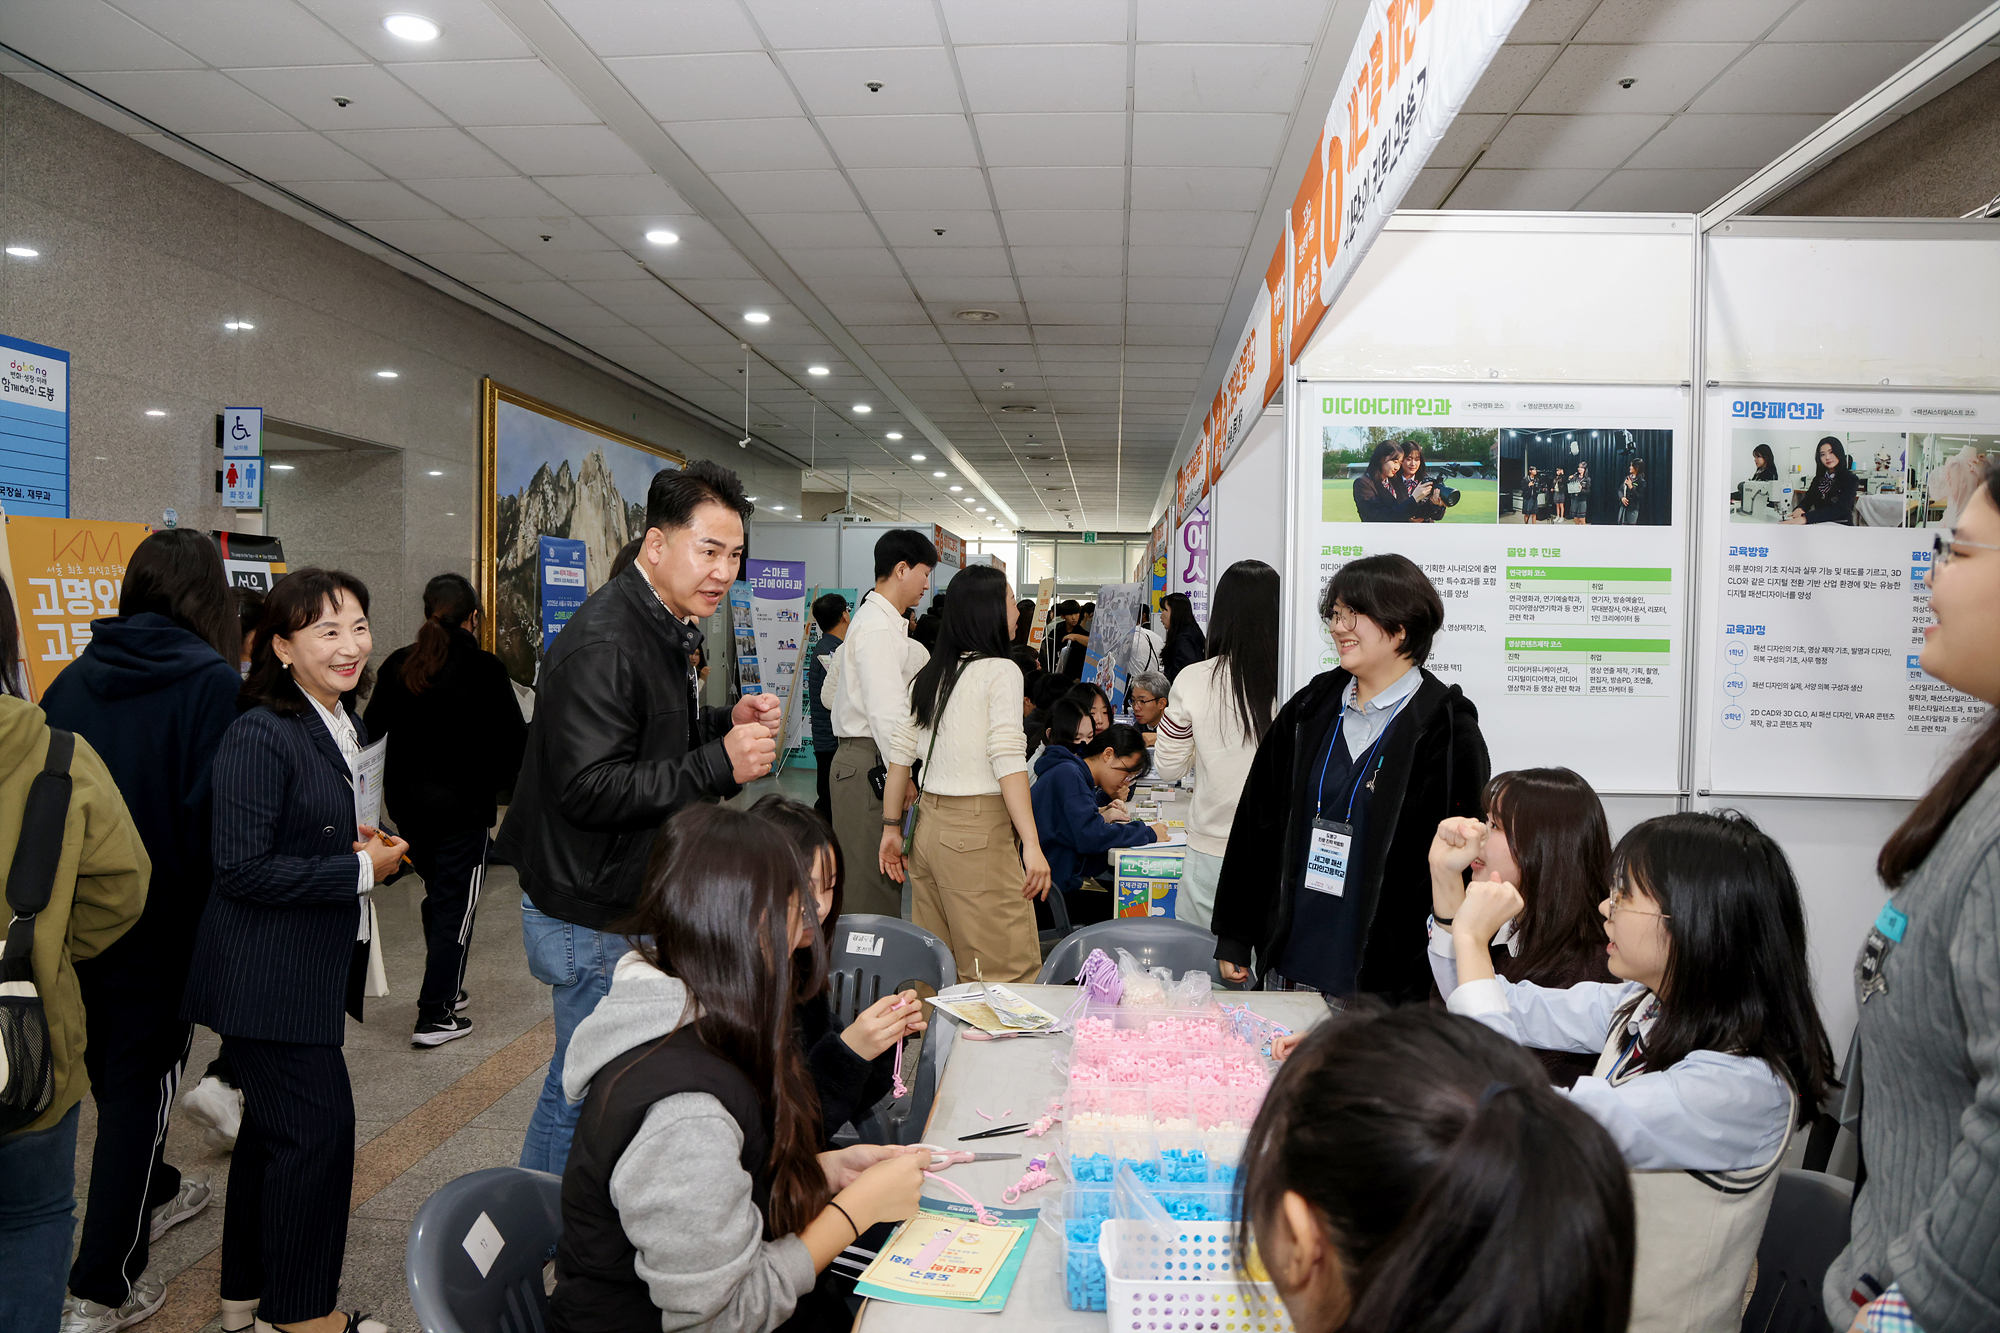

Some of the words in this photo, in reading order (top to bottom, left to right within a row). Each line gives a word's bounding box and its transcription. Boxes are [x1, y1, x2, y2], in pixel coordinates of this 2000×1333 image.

[1372, 138, 1392, 203] 키링
[1390, 66, 1428, 174] 만들기
[10, 360, 46, 377] dobong
[2, 377, 36, 395] 함께해요!
[38, 386, 54, 401] 도봉
[1322, 397, 1452, 416] 미디어디자인과
[1732, 400, 1824, 419] 의상패션과
[28, 490, 50, 501] 재무과
[230, 491, 253, 499] 화장실
[1320, 546, 1364, 556] 교육방향
[1507, 547, 1526, 557] 졸업
[1529, 548, 1539, 557] 후
[1542, 548, 1561, 558] 진로
[1729, 546, 1769, 558] 교육방향
[1912, 552, 1931, 561] 졸업
[47, 563, 63, 576] 서울
[68, 564, 83, 575] 최초
[762, 567, 789, 578] 스마트
[1425, 564, 1445, 573] 기획한
[1447, 565, 1481, 573] 시나리오에
[1483, 565, 1496, 573] 출연
[1743, 565, 1763, 573] 분야의
[1844, 568, 1864, 576] 태도를
[1866, 568, 1889, 577] 기르고,
[750, 578, 802, 590] 크리에이터과
[1768, 578, 1788, 586] 디지털
[1823, 580, 1837, 588] 산업
[1840, 580, 1860, 588] 환경에
[1863, 581, 1877, 589] 맞는
[1880, 582, 1901, 590] 유능한
[1455, 590, 1468, 598] 양성
[1728, 590, 1746, 598] 디지털
[1748, 590, 1795, 599] 패션디자이너를
[1798, 592, 1811, 600] 양성
[1448, 624, 1486, 632] 영상제작기초,
[1726, 624, 1766, 636] 교육과정
[1908, 705, 1965, 713] 뷰티스타일리스트과,
[1314, 855, 1330, 864] 세그루
[1331, 859, 1342, 868] 패션
[910, 1271, 950, 1282] 도봉구
